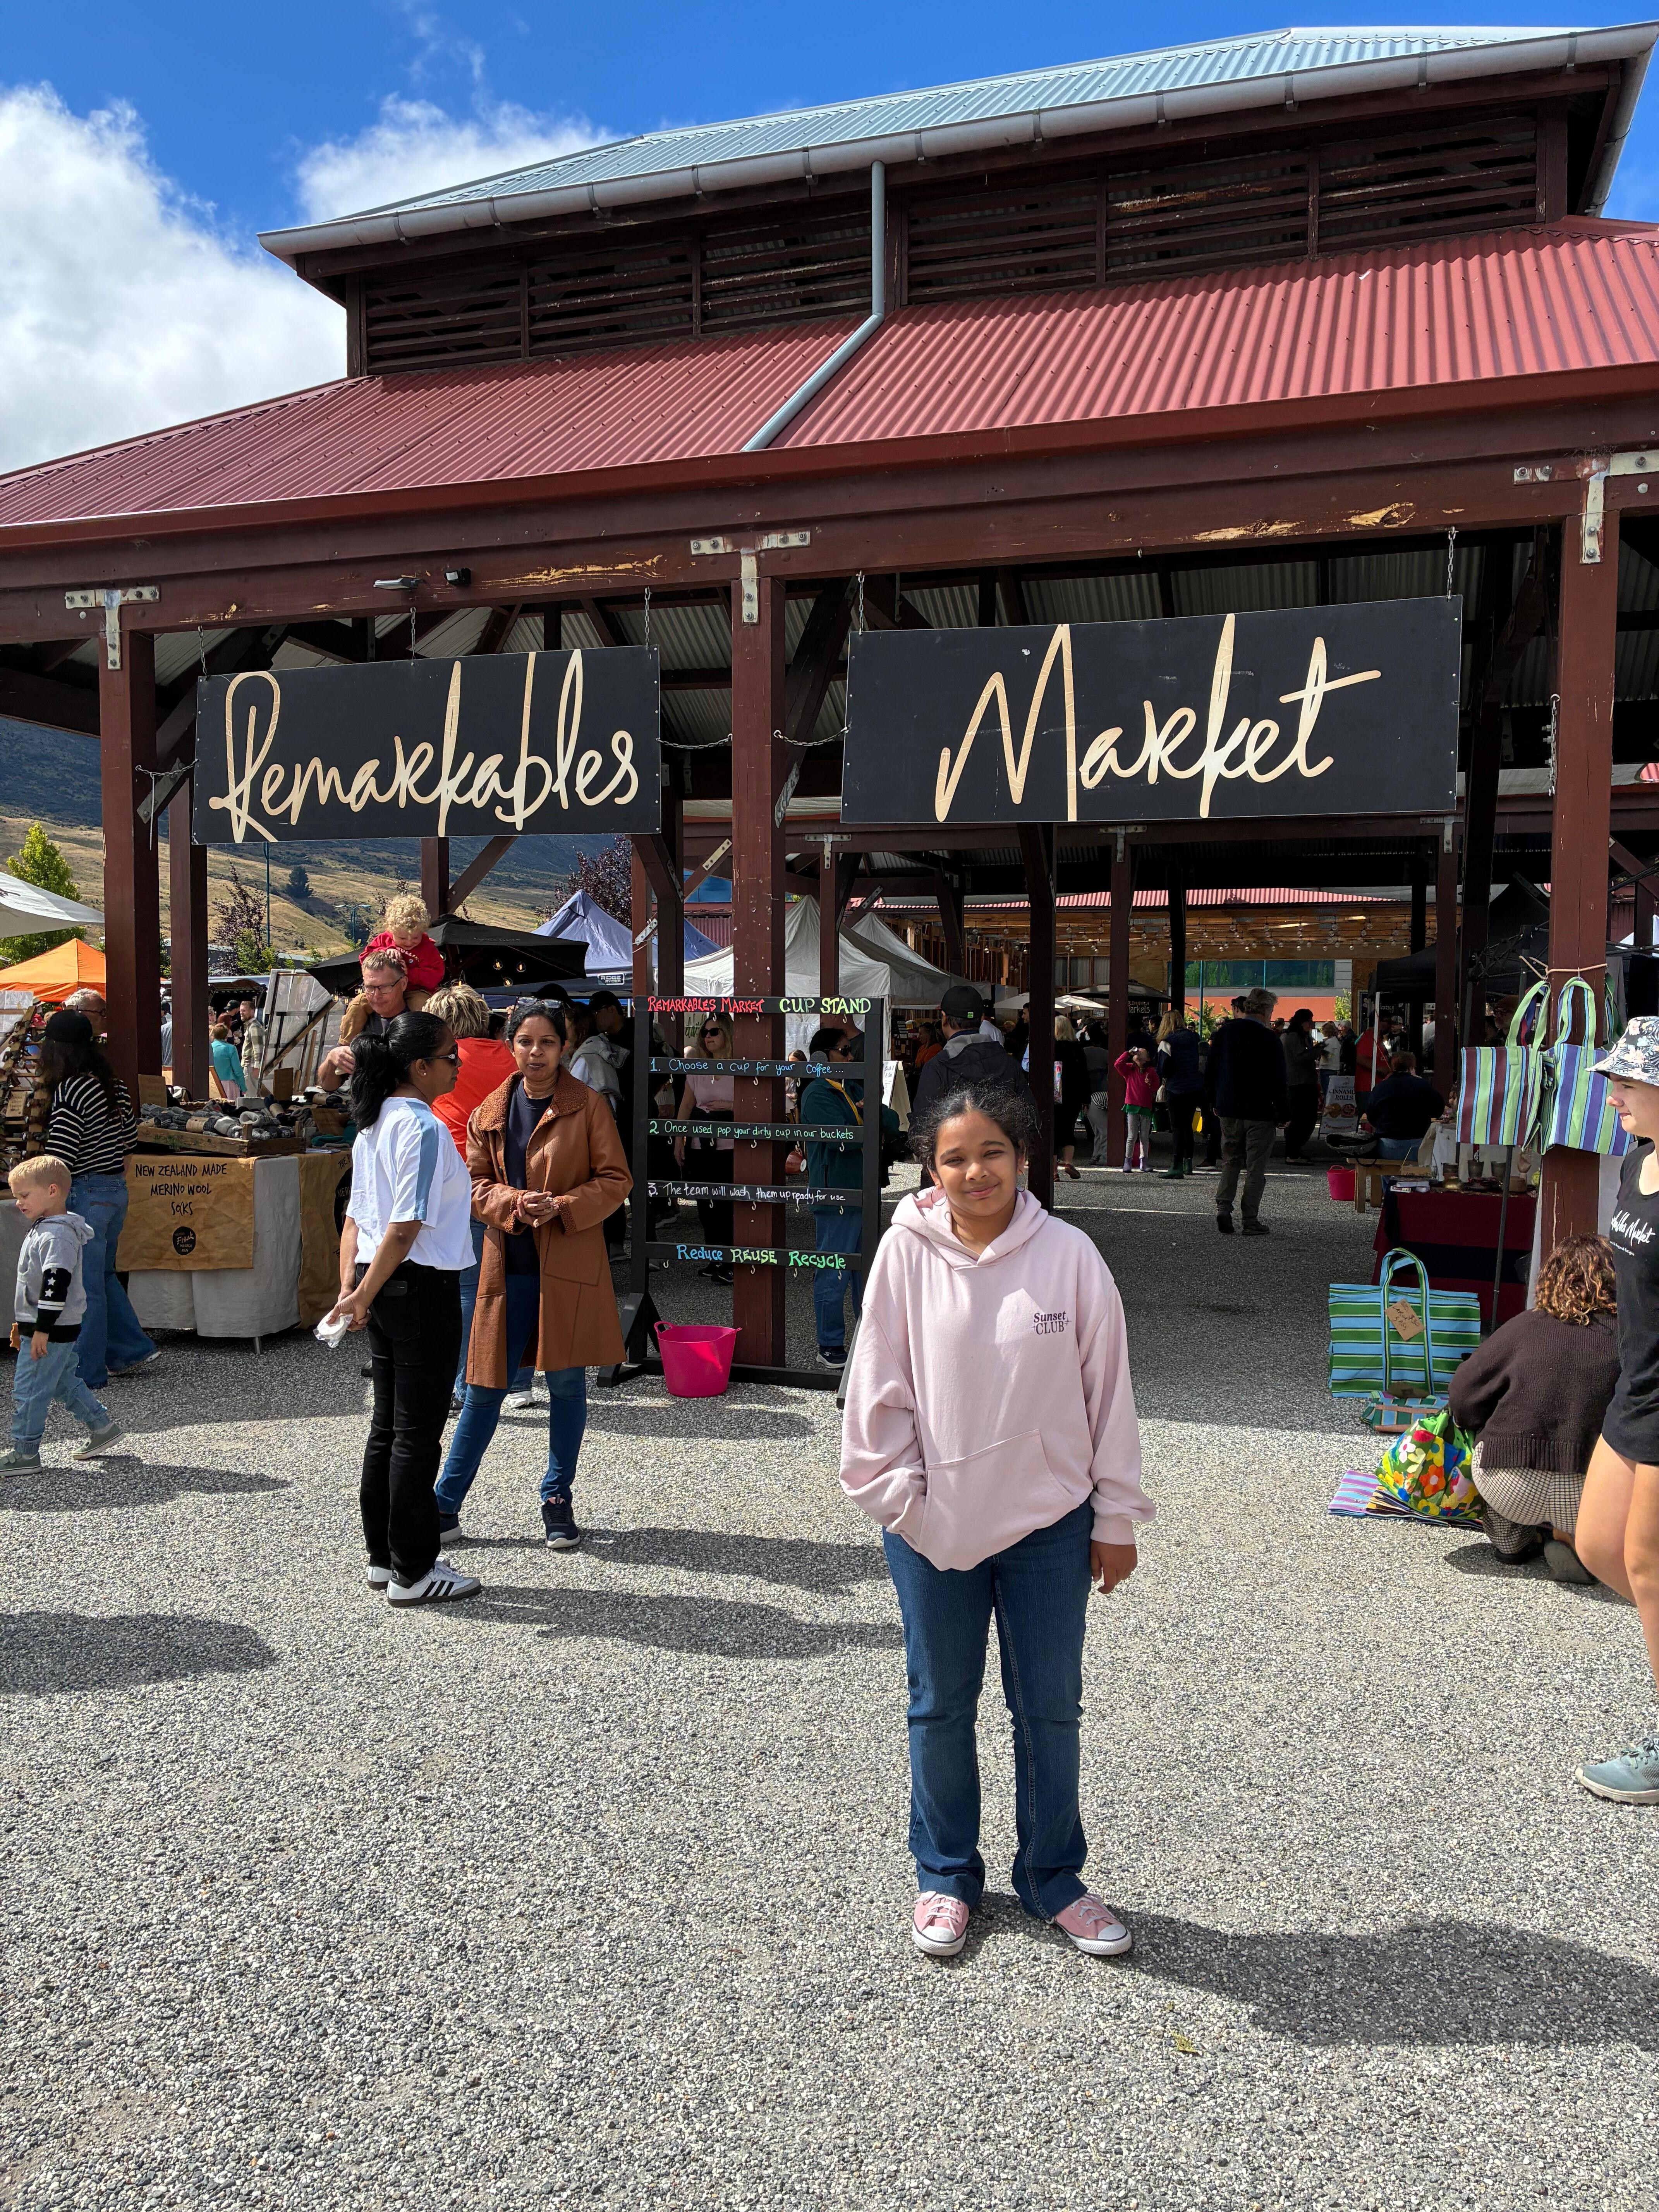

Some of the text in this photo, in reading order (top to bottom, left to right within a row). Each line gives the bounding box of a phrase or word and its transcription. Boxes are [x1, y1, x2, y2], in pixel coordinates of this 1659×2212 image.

[934, 613, 1382, 822] Market
[209, 649, 638, 843] Remarkables
[647, 996, 871, 1014] REMARKABLES MARKET CUP STAND
[650, 1058, 661, 1072] 1.
[669, 1059, 708, 1073] Choose
[730, 1063, 749, 1073] cup
[756, 1061, 769, 1075] for
[776, 1064, 795, 1076] your
[806, 1063, 832, 1078] Coffee
[665, 1121, 688, 1133] Once
[692, 1124, 713, 1134] used
[717, 1127, 731, 1137] pop
[734, 1128, 751, 1139] your
[752, 1126, 771, 1139] dirty
[776, 1129, 790, 1139] cup
[820, 1127, 854, 1140] buckets
[136, 1163, 228, 1178] NEW ZEALAND MADE
[338, 1157, 347, 1169] THE
[150, 1183, 212, 1196] MERINO WOOL
[647, 1182, 658, 1197] 3.
[663, 1182, 682, 1196] The
[684, 1183, 709, 1196] team
[712, 1186, 726, 1197] will
[730, 1186, 750, 1200] wash
[756, 1187, 778, 1200] them
[780, 1191, 791, 1200] up
[792, 1188, 814, 1205] ready
[814, 1190, 827, 1202] for
[171, 1202, 193, 1216] SOCKS
[1624, 1218, 1656, 1247] Market
[676, 1244, 847, 1269] Reduce REUSE Recycle
[1033, 1310, 1066, 1323] Sunset
[1036, 1321, 1065, 1335] CLUB
